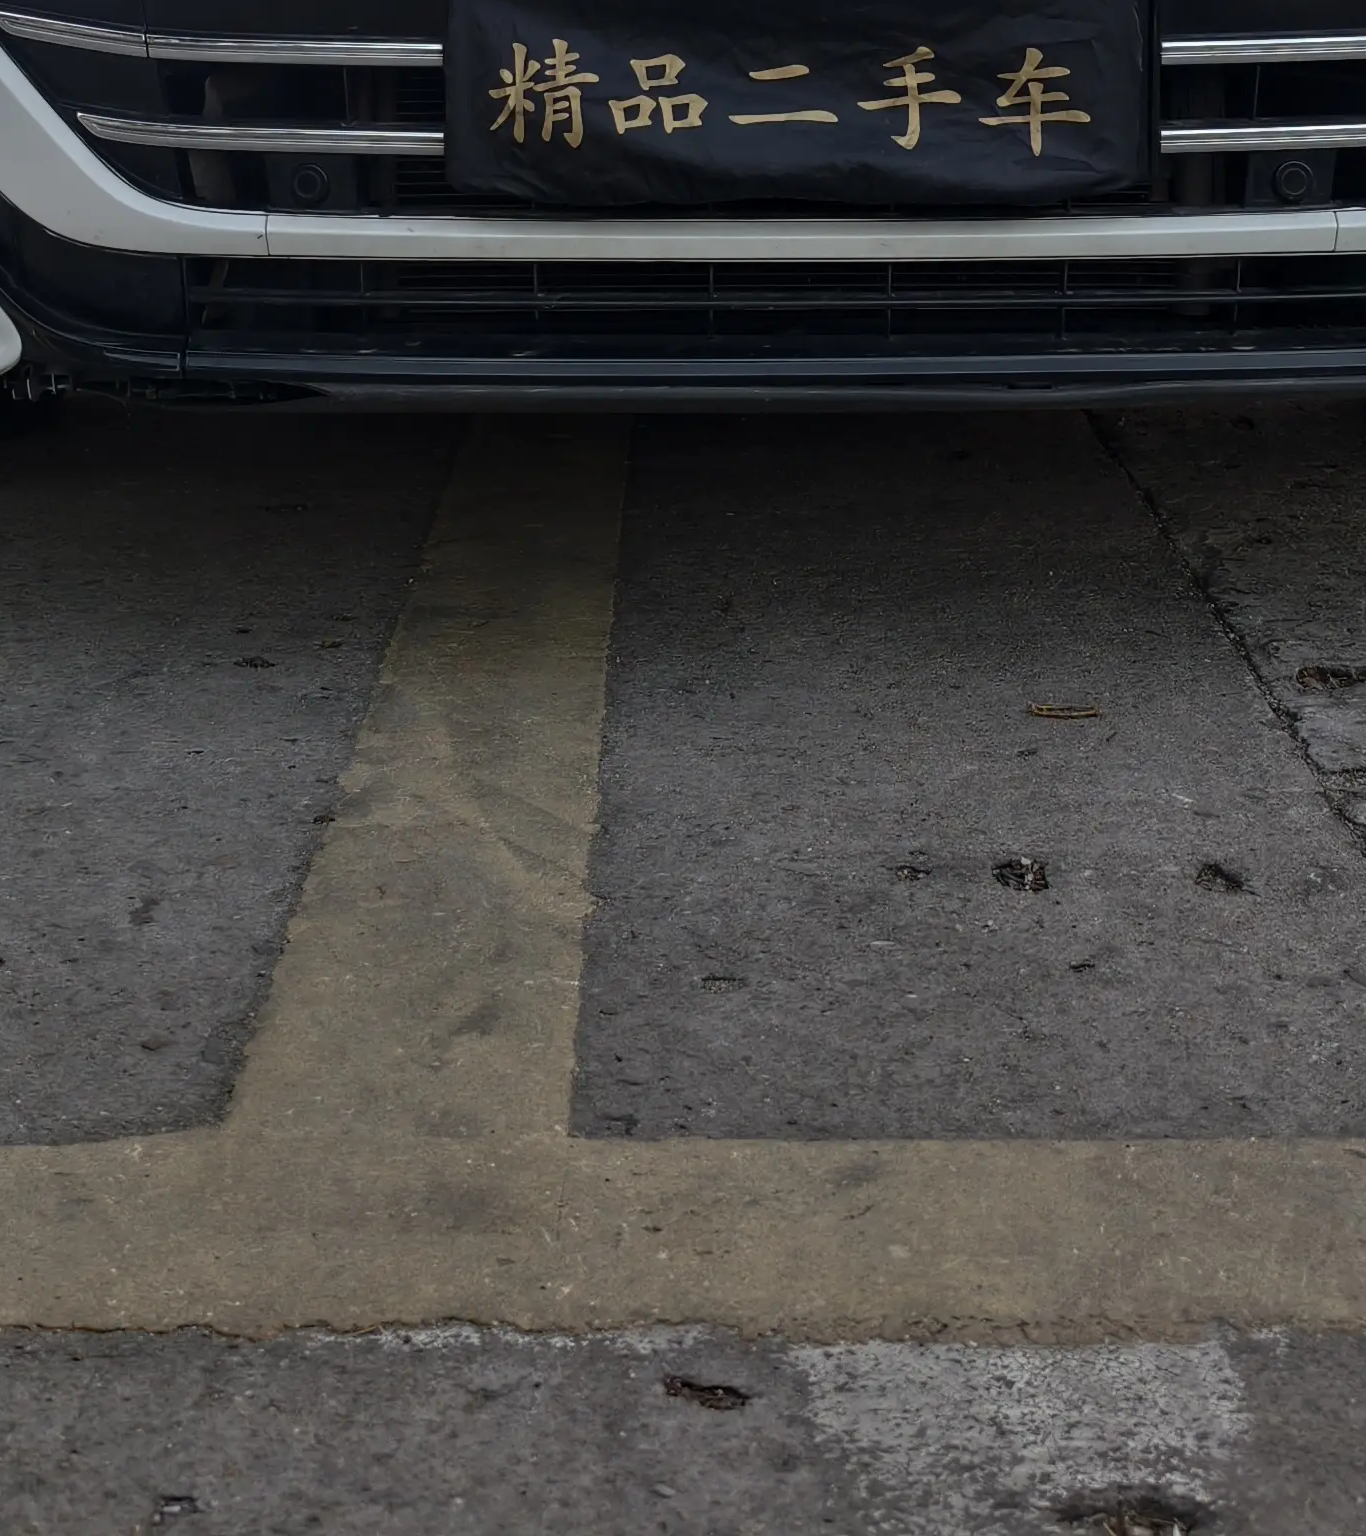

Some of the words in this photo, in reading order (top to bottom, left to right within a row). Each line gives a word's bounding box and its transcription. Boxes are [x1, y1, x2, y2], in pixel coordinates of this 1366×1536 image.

[488, 38, 1092, 156] 精品二手车
